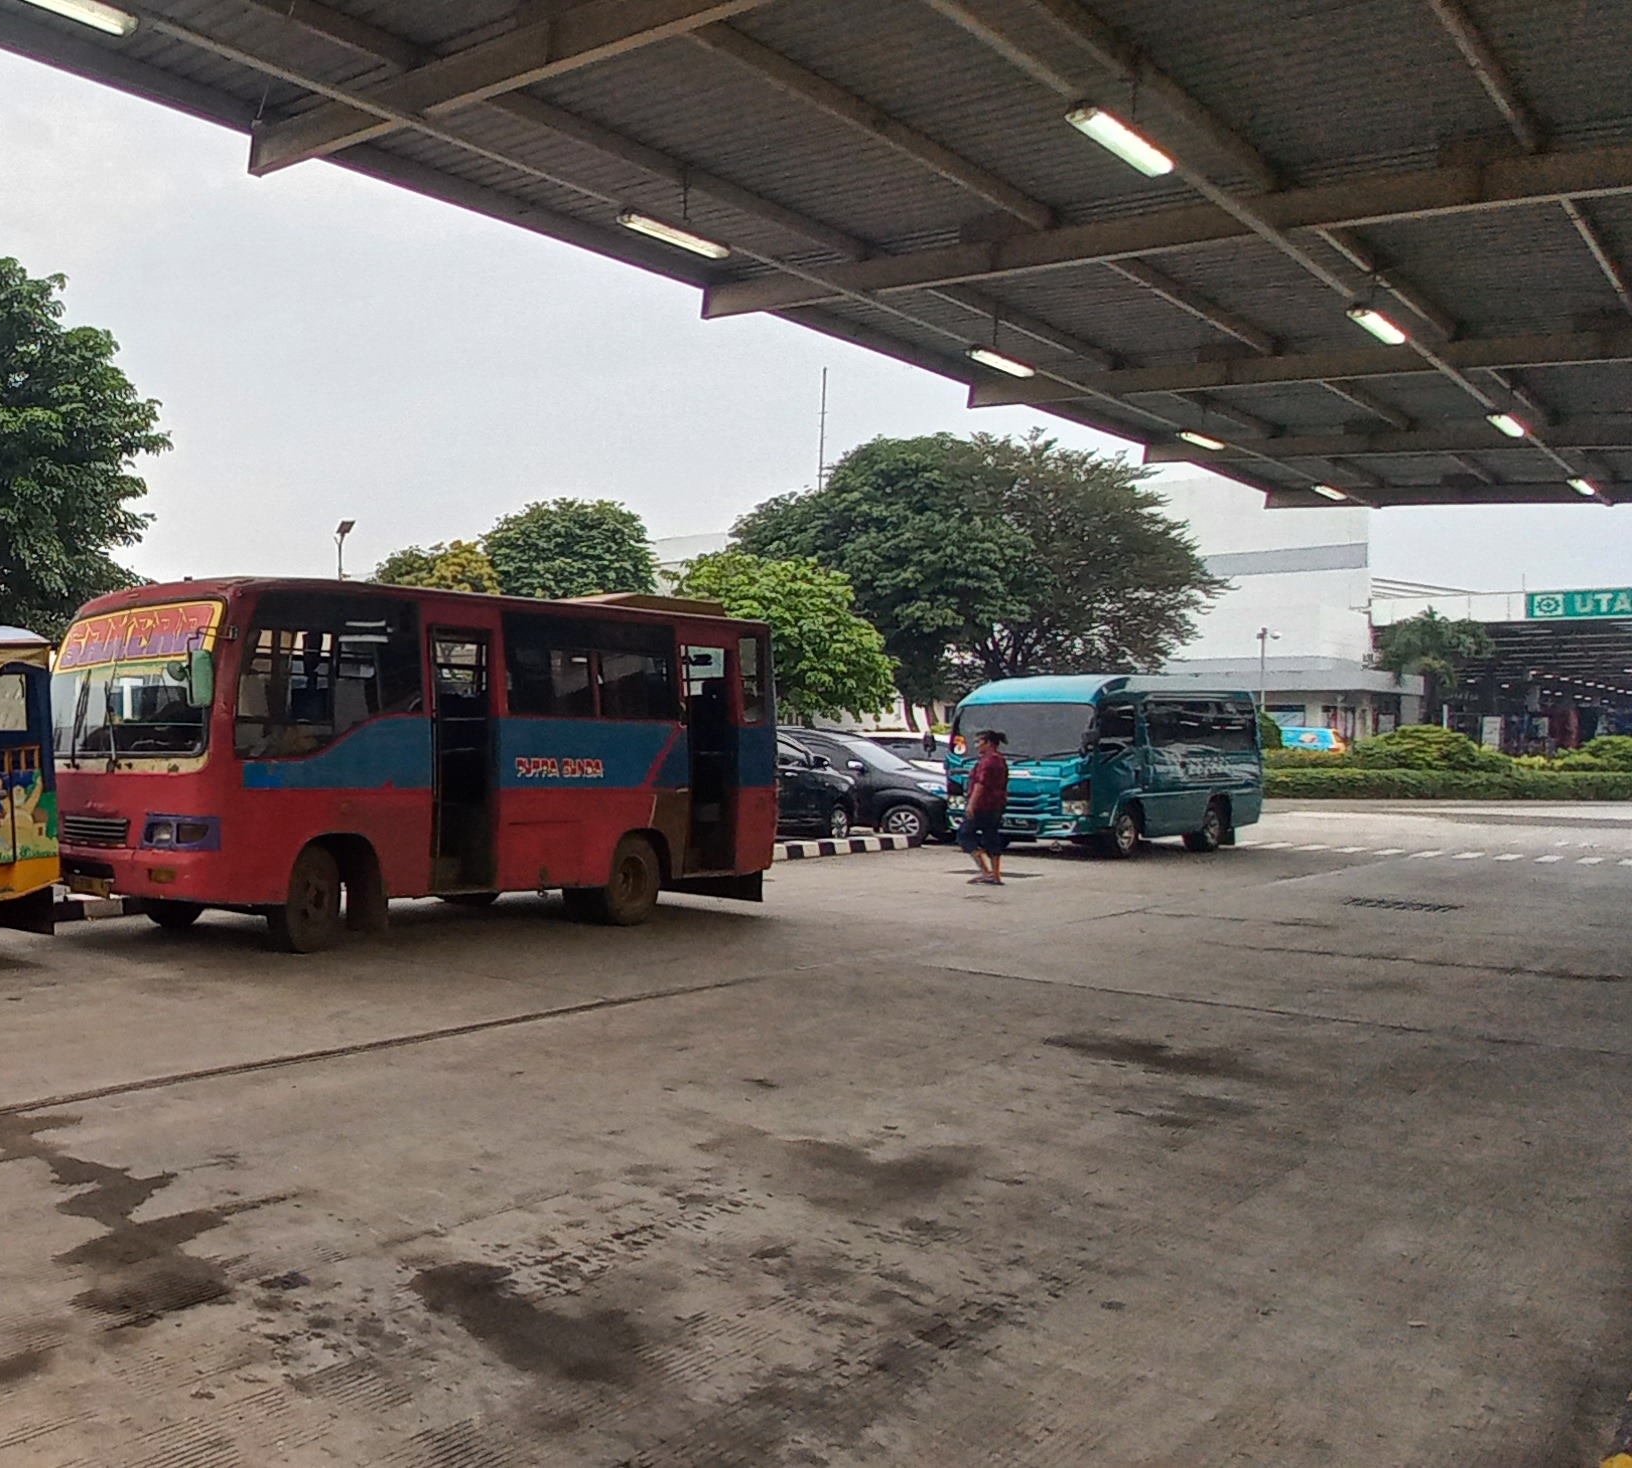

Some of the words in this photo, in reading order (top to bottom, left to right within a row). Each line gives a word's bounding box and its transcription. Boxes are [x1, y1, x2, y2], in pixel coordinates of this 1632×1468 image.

[1573, 592, 1632, 613] UTA
[515, 757, 559, 778] PUTRA
[562, 757, 604, 778] BUNDA
